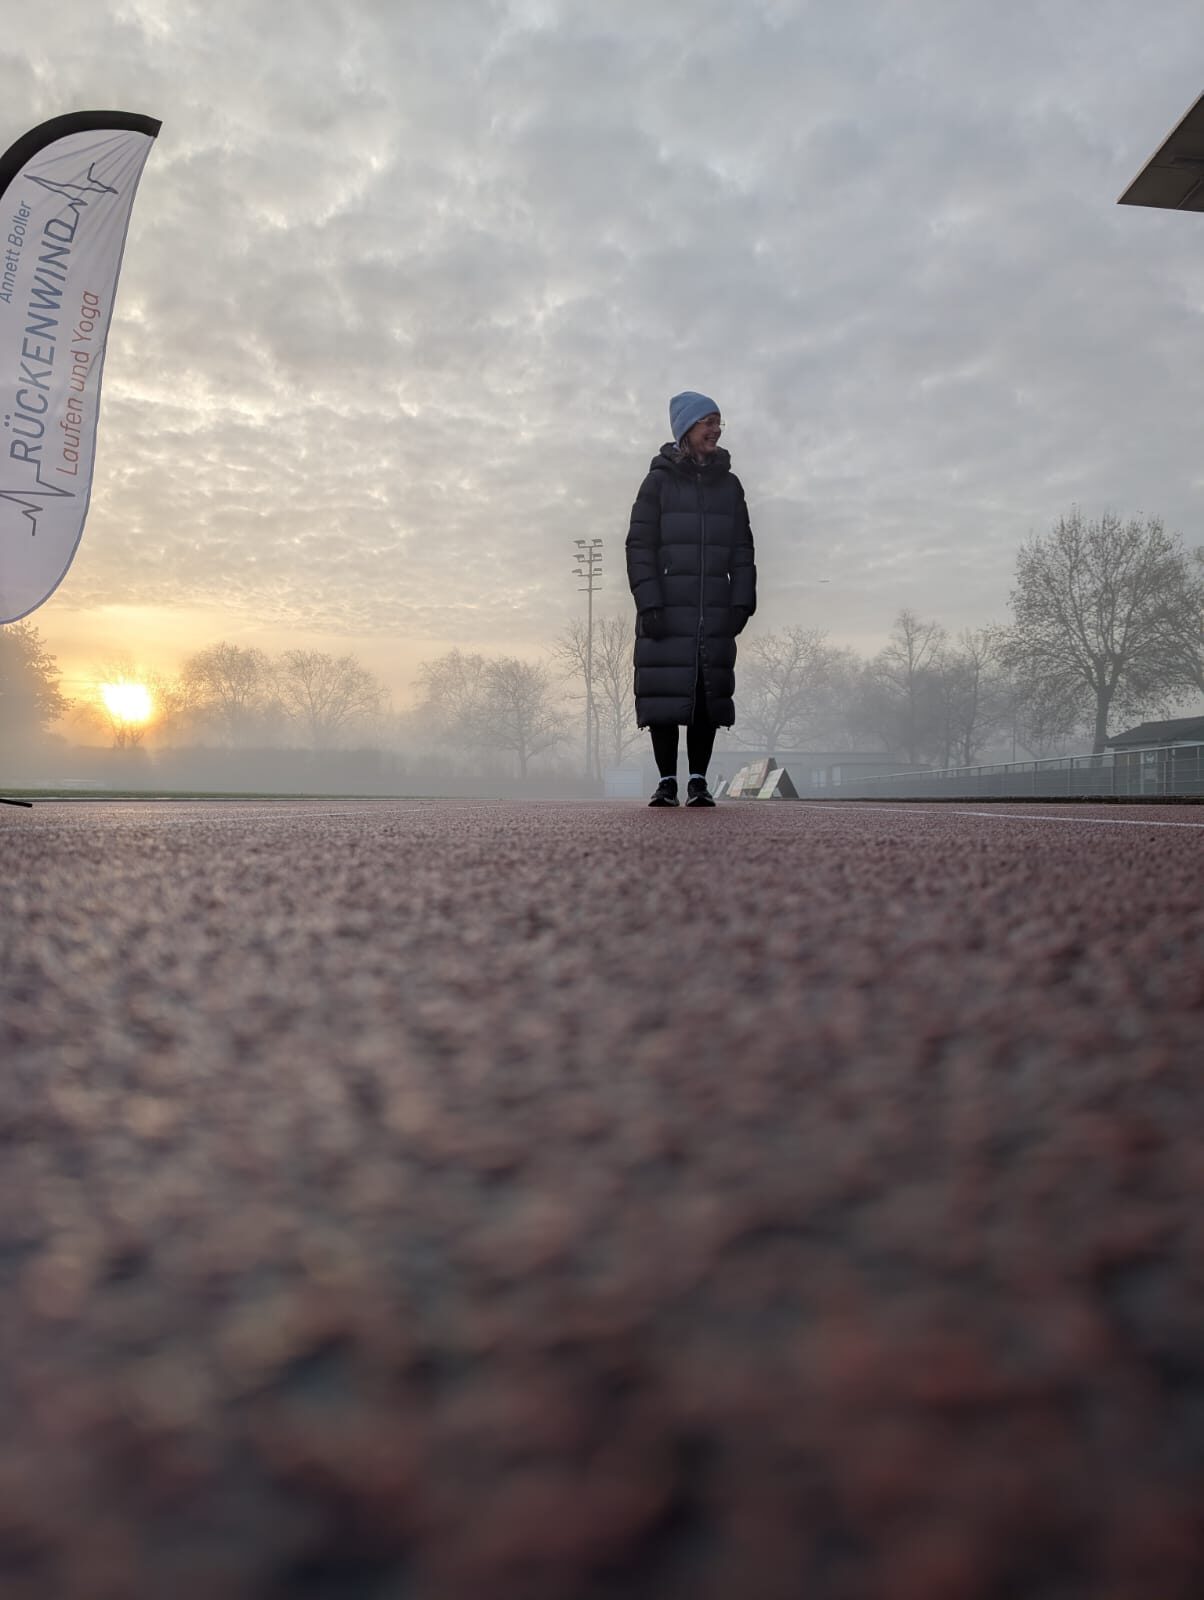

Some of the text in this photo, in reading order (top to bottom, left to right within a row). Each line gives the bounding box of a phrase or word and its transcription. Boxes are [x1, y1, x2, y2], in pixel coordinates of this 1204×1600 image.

[0, 201, 32, 303] Annett Boller
[4, 218, 73, 463] RÜCKENWIND
[56, 290, 101, 476] Laufen und Yoga
